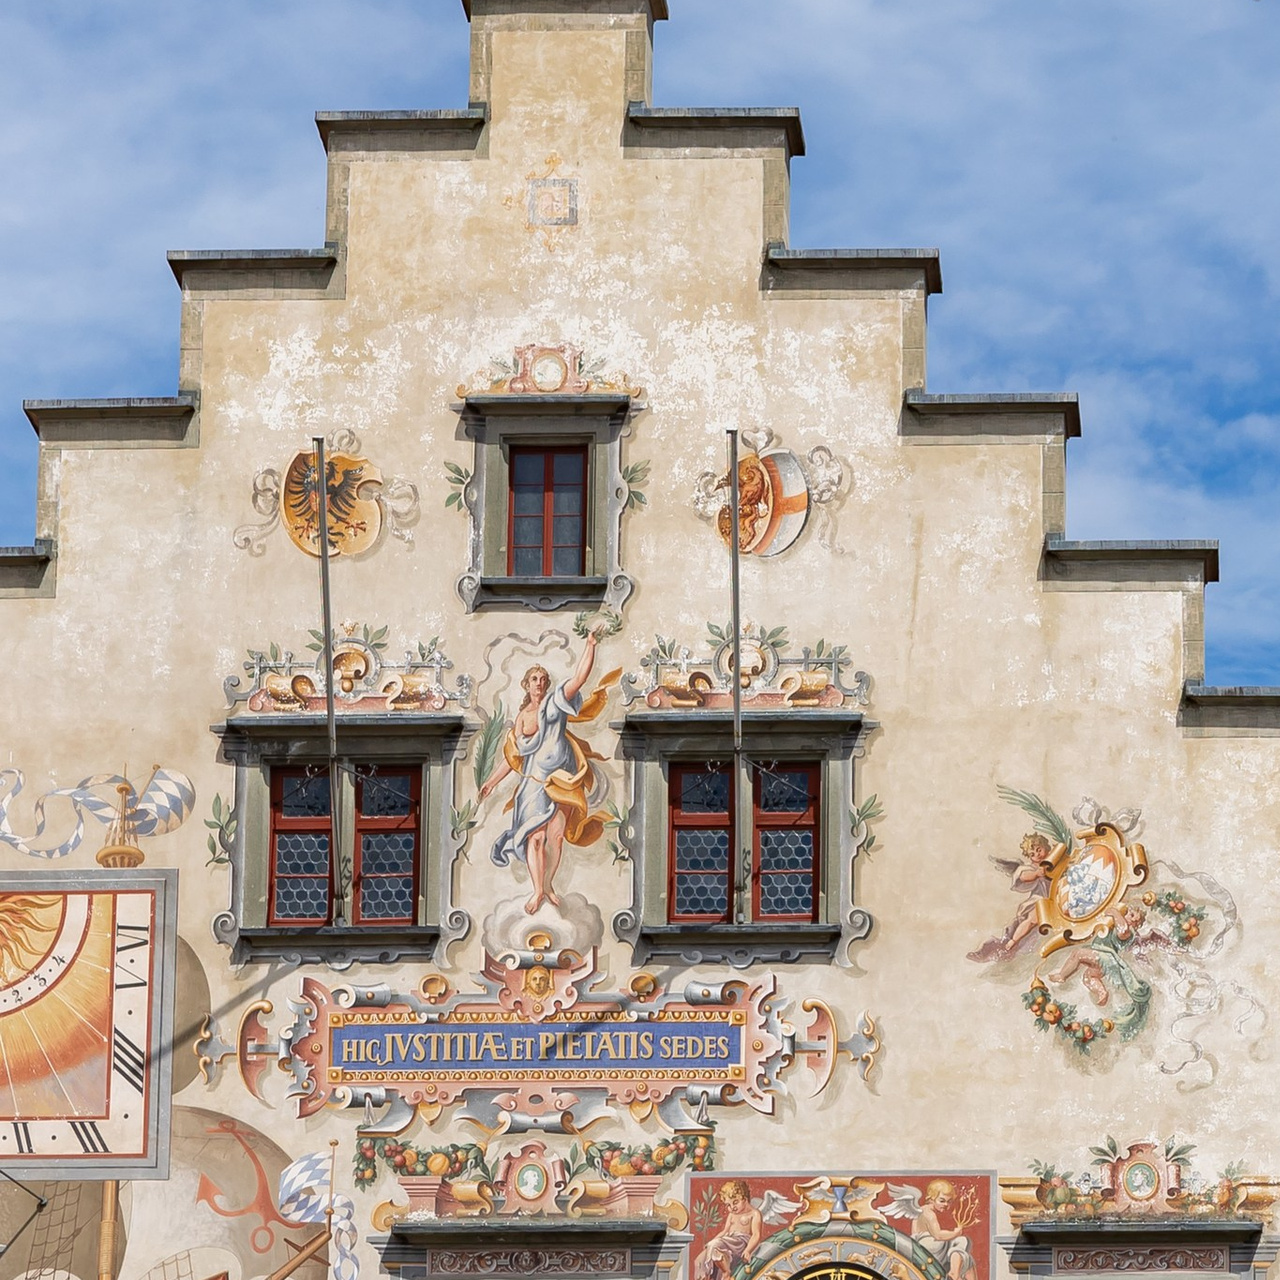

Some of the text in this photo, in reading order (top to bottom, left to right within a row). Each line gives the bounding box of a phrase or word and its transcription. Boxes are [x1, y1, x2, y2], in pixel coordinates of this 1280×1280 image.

[342, 1039, 381, 1062] HIC
[510, 1037, 535, 1060] ET
[537, 1032, 654, 1060] PIETATIS
[660, 1036, 729, 1059] SEDES
[11, 1122, 36, 1154] II
[67, 1121, 113, 1154] III
